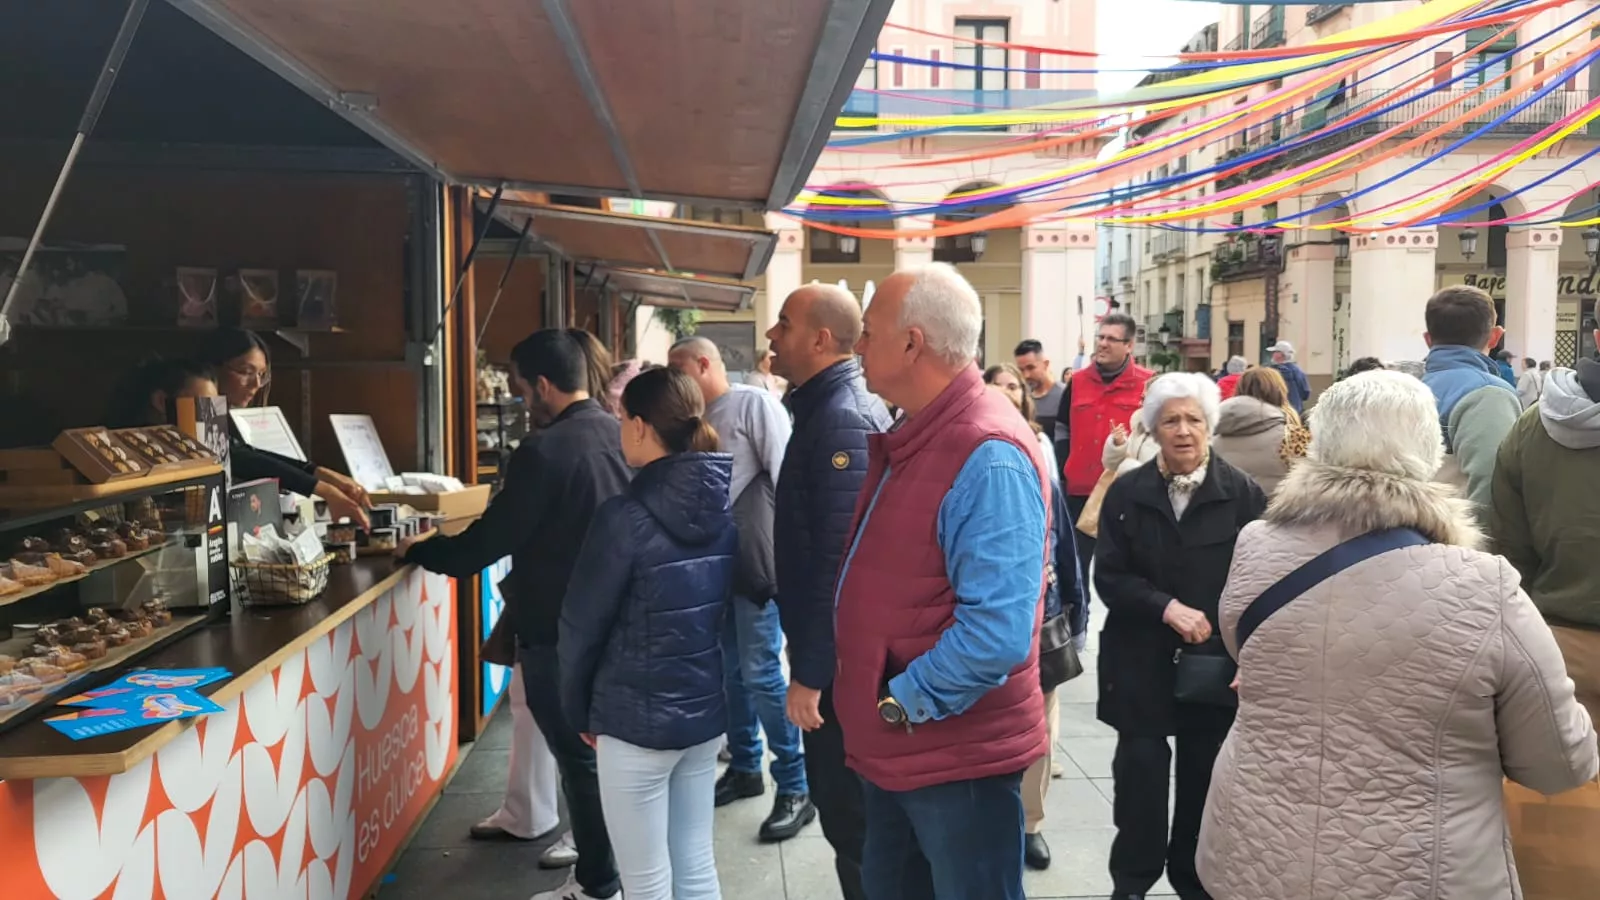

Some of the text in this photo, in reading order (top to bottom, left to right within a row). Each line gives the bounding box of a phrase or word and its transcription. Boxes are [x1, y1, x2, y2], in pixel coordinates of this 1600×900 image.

[358, 703, 419, 804] Huesca
[358, 750, 425, 863] es dulce
